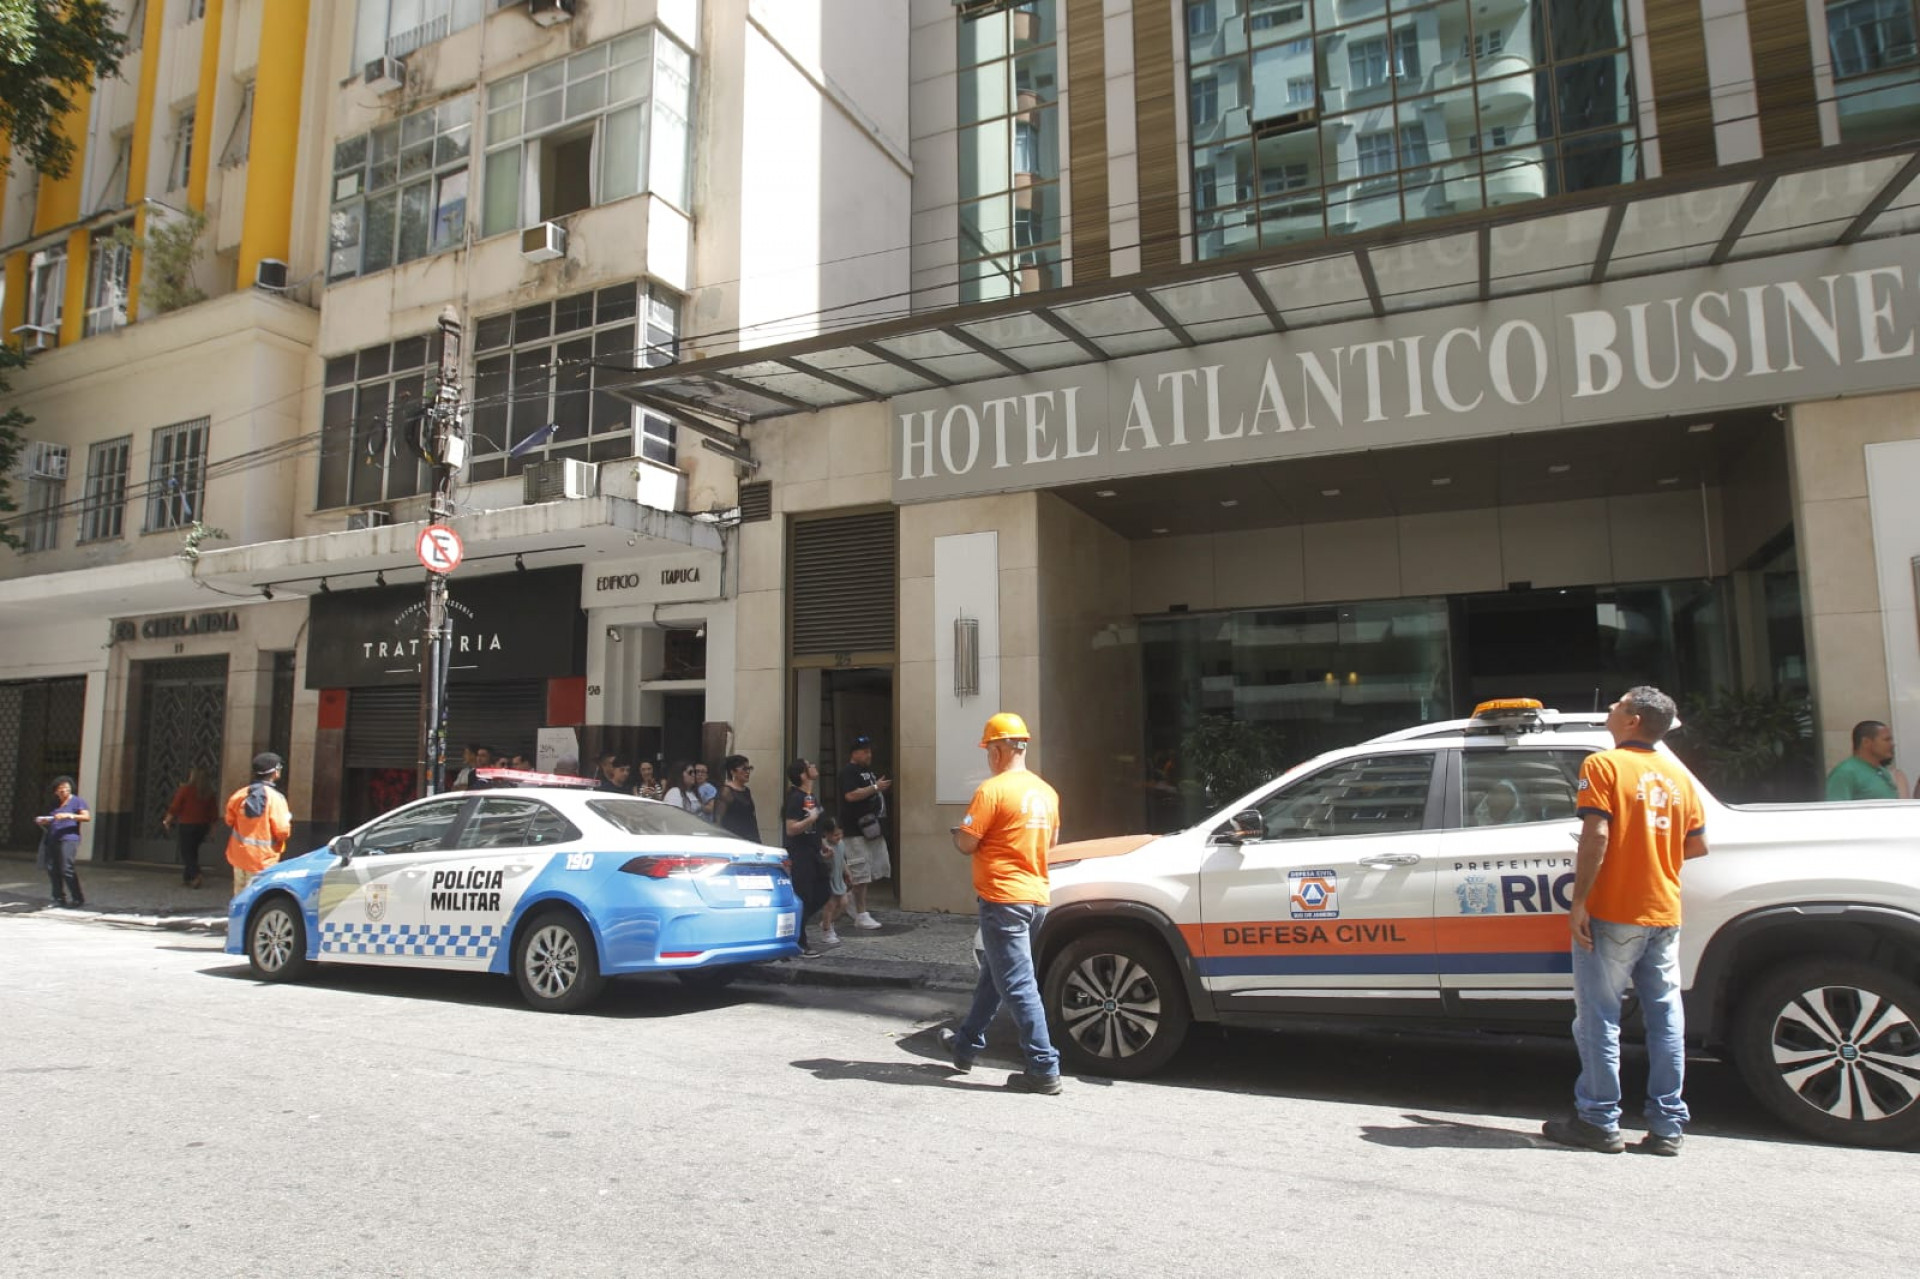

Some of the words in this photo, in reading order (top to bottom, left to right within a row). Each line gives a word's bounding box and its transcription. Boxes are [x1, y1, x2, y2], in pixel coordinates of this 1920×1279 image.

[899, 386, 1099, 480] HOTEL
[1117, 319, 1548, 452] ATLANTICO
[1565, 265, 1920, 398] BUSINE
[661, 567, 699, 585] ITAPUCA
[363, 633, 502, 659] TRATRIA
[565, 853, 595, 870] 190
[1454, 858, 1573, 871] PREFEITUR
[432, 866, 503, 889] POLÍCIA
[431, 892, 501, 911] MILITAR
[1223, 925, 1329, 945] DEFESA
[1336, 924, 1406, 942] CIVIL
